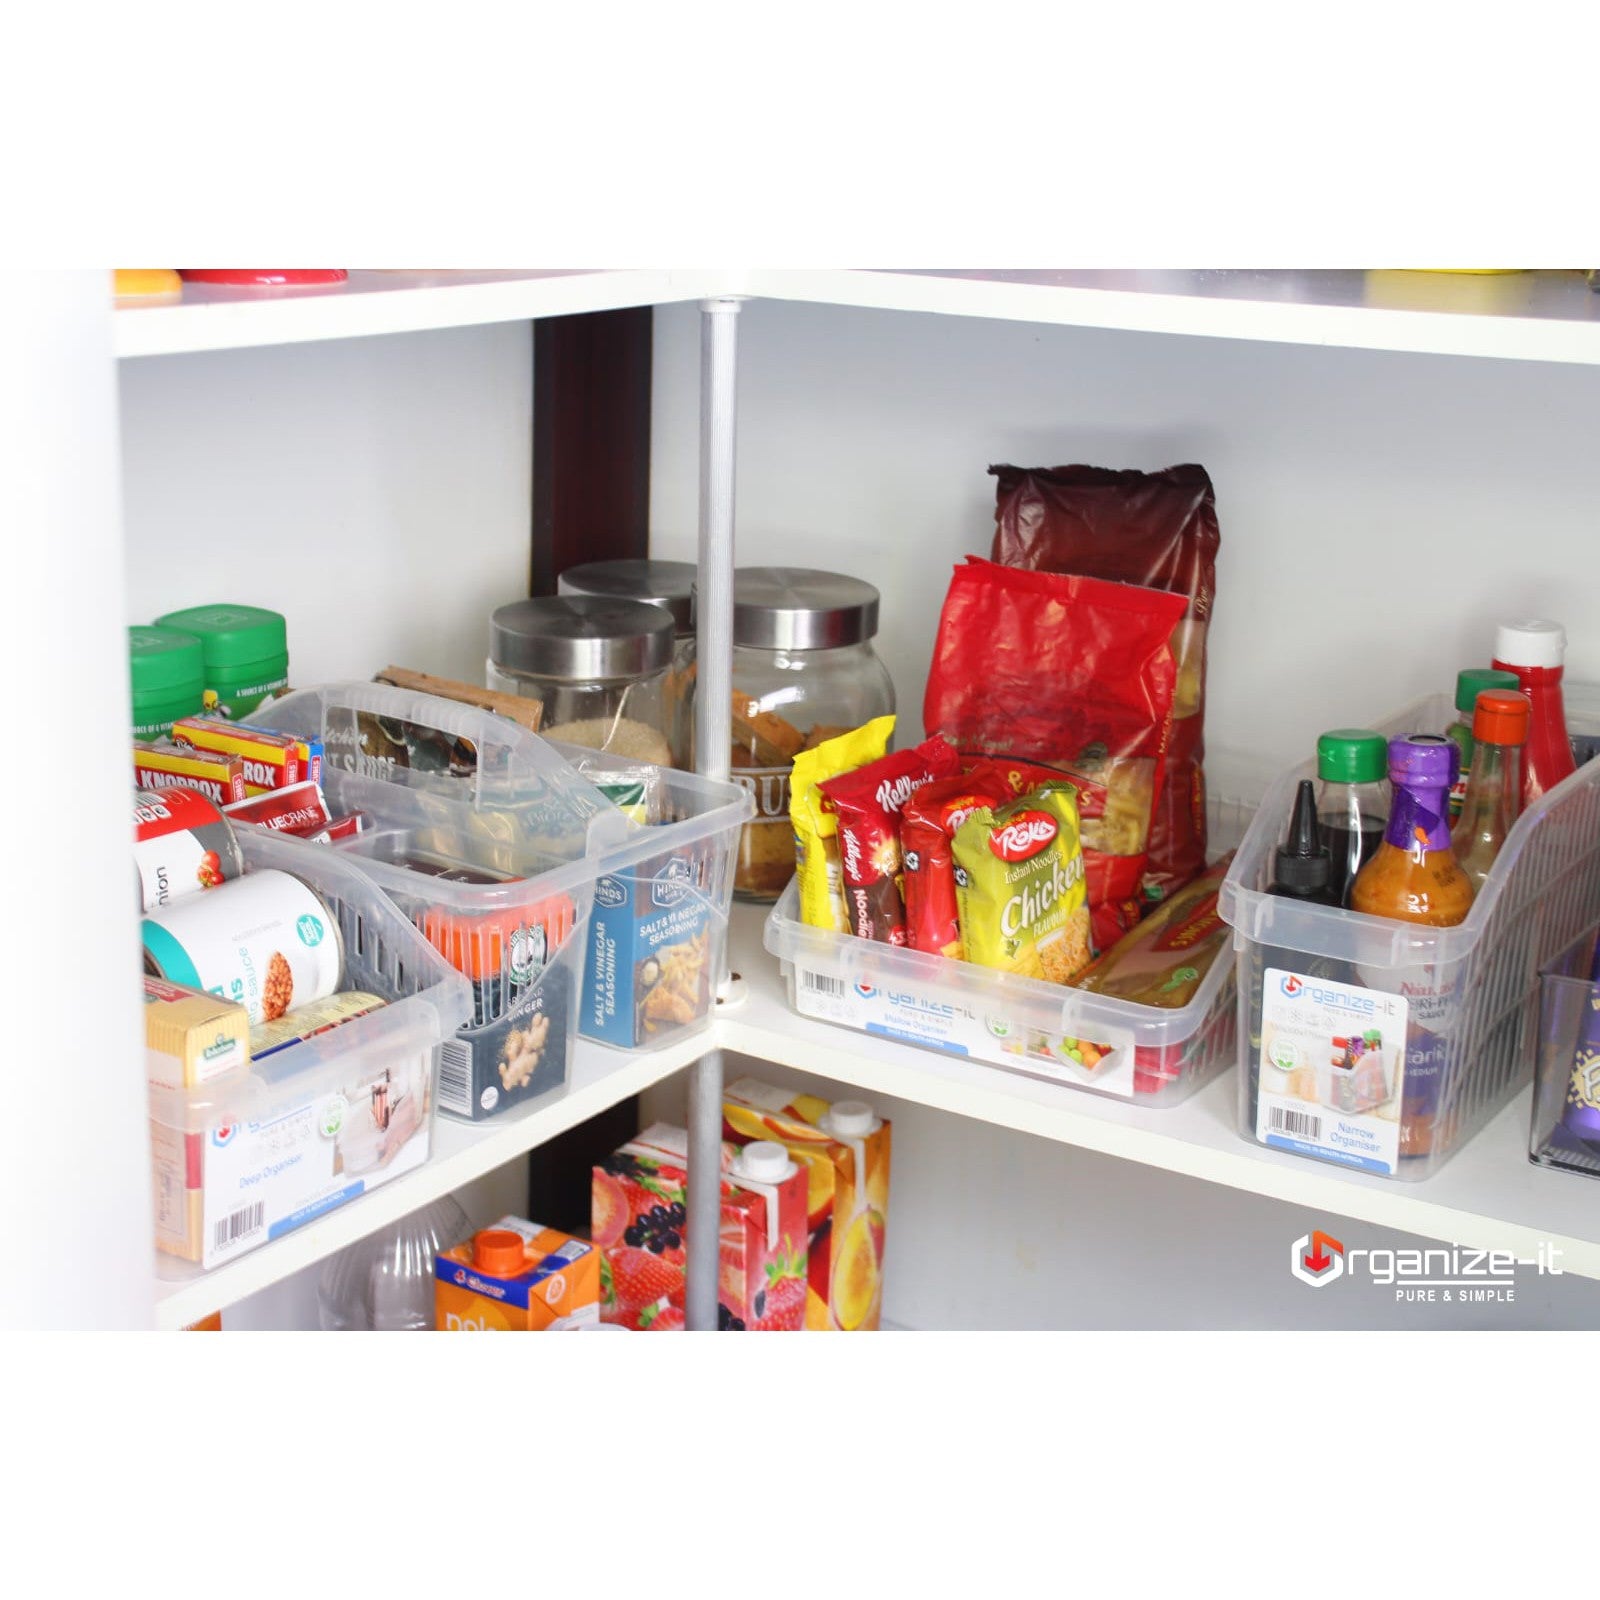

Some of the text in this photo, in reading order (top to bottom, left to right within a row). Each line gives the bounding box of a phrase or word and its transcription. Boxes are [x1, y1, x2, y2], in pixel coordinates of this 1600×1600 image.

[1004, 850, 1064, 885] Instant Noodles
[1000, 853, 1085, 938] Chicken
[639, 918, 661, 938] SALT
[853, 888, 869, 939] Noodle
[595, 920, 607, 983] VINEGAR
[605, 938, 617, 1016] SEASONING
[594, 996, 606, 1028] SALT
[1329, 1131, 1382, 1152] Organiser
[1337, 1122, 1375, 1140] Narrow
